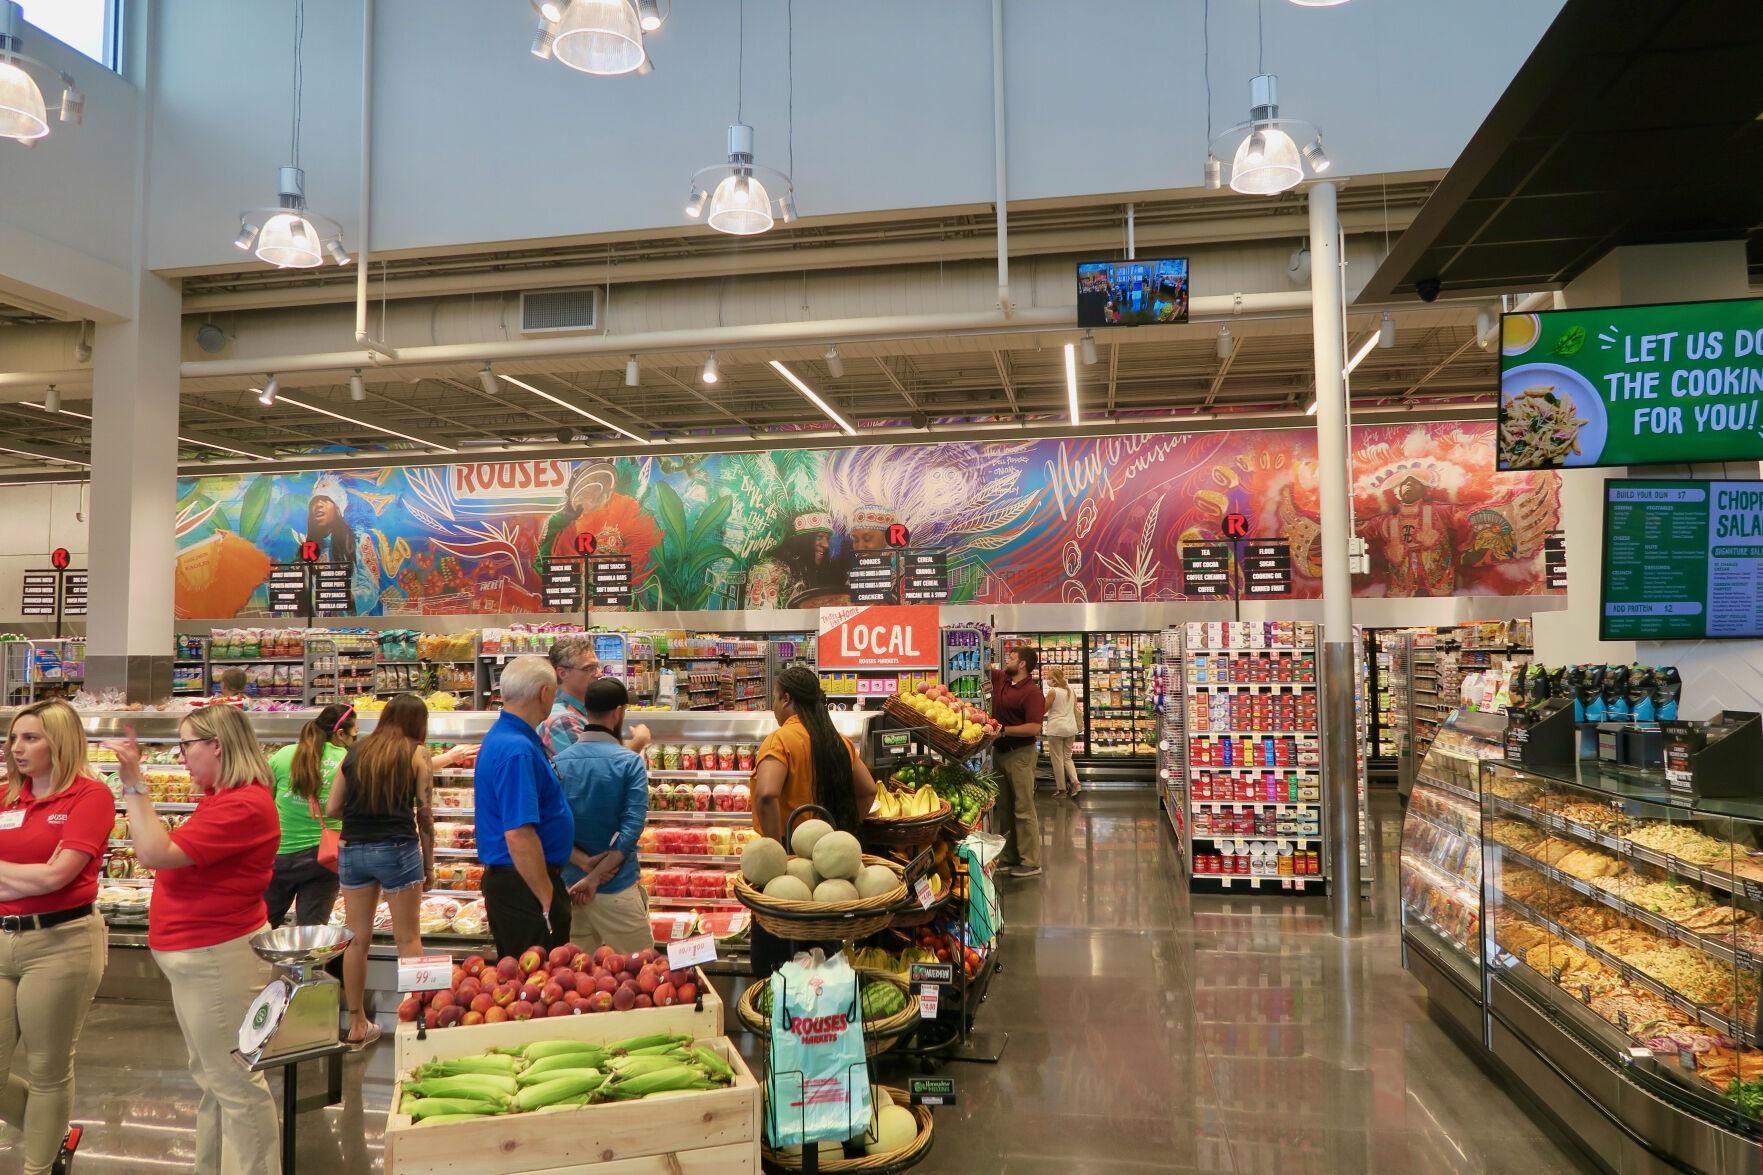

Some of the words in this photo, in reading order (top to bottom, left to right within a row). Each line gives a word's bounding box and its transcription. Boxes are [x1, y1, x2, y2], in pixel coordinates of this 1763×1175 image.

[1625, 331, 1679, 364] LET
[1686, 331, 1723, 360] US
[1604, 371, 1659, 402] THE
[1671, 366, 1763, 398] COOKIN
[1634, 407, 1683, 436] FOR
[1694, 400, 1758, 432] YOU!
[456, 460, 565, 493] ROUSES
[1044, 439, 1101, 521] New
[1106, 434, 1155, 466] Orle
[1098, 434, 1192, 502] Louisian
[1616, 490, 1634, 499] BUILD
[1636, 491, 1652, 499] YOUR
[1678, 491, 1686, 500] $7
[890, 524, 907, 546] R
[1227, 514, 1246, 536] R
[1716, 513, 1763, 538] SALA
[303, 541, 317, 561] R
[578, 534, 594, 553] R
[1612, 604, 1625, 613] ADD
[1627, 604, 1653, 612] PROTEIN
[1665, 604, 1672, 613] $2
[841, 623, 920, 657] LOCAL
[790, 1013, 847, 1036] ROUSES
[801, 1033, 837, 1045] MARKETS
